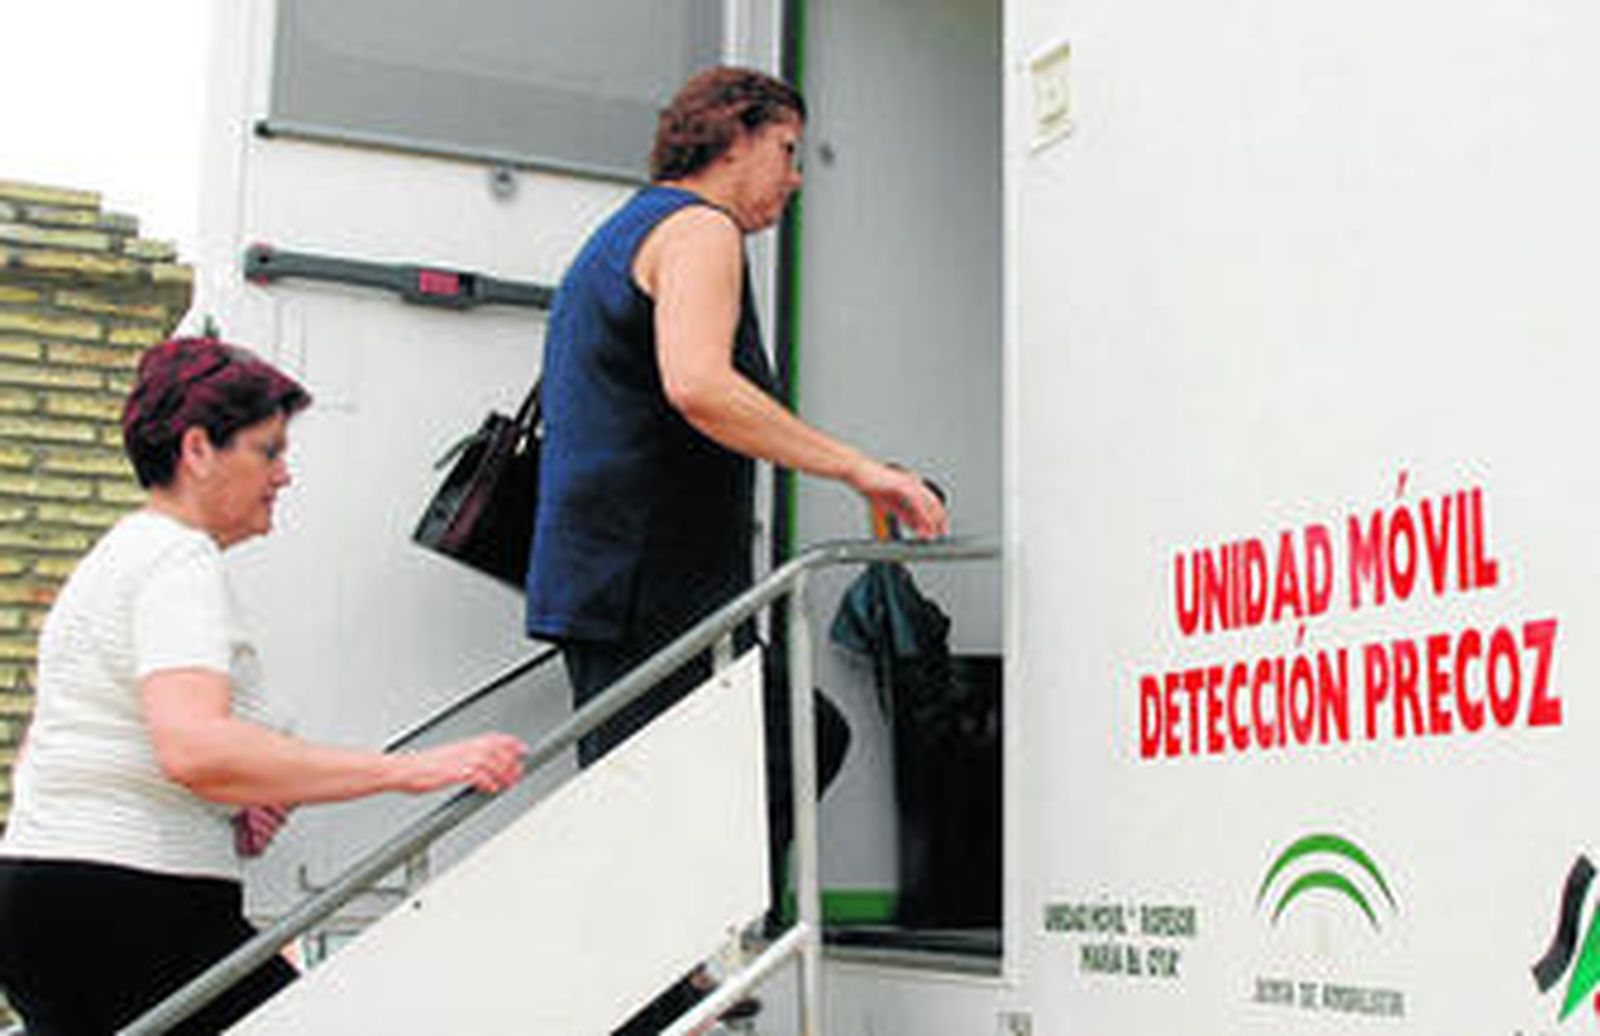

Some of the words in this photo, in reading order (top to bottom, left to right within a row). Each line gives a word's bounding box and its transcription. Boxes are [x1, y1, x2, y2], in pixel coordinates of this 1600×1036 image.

[1175, 524, 1332, 635] UNIDAD
[1348, 472, 1498, 609] MÓVIL
[1140, 626, 1348, 758] DETECCIÓN
[1364, 619, 1562, 740] PRECOZ
